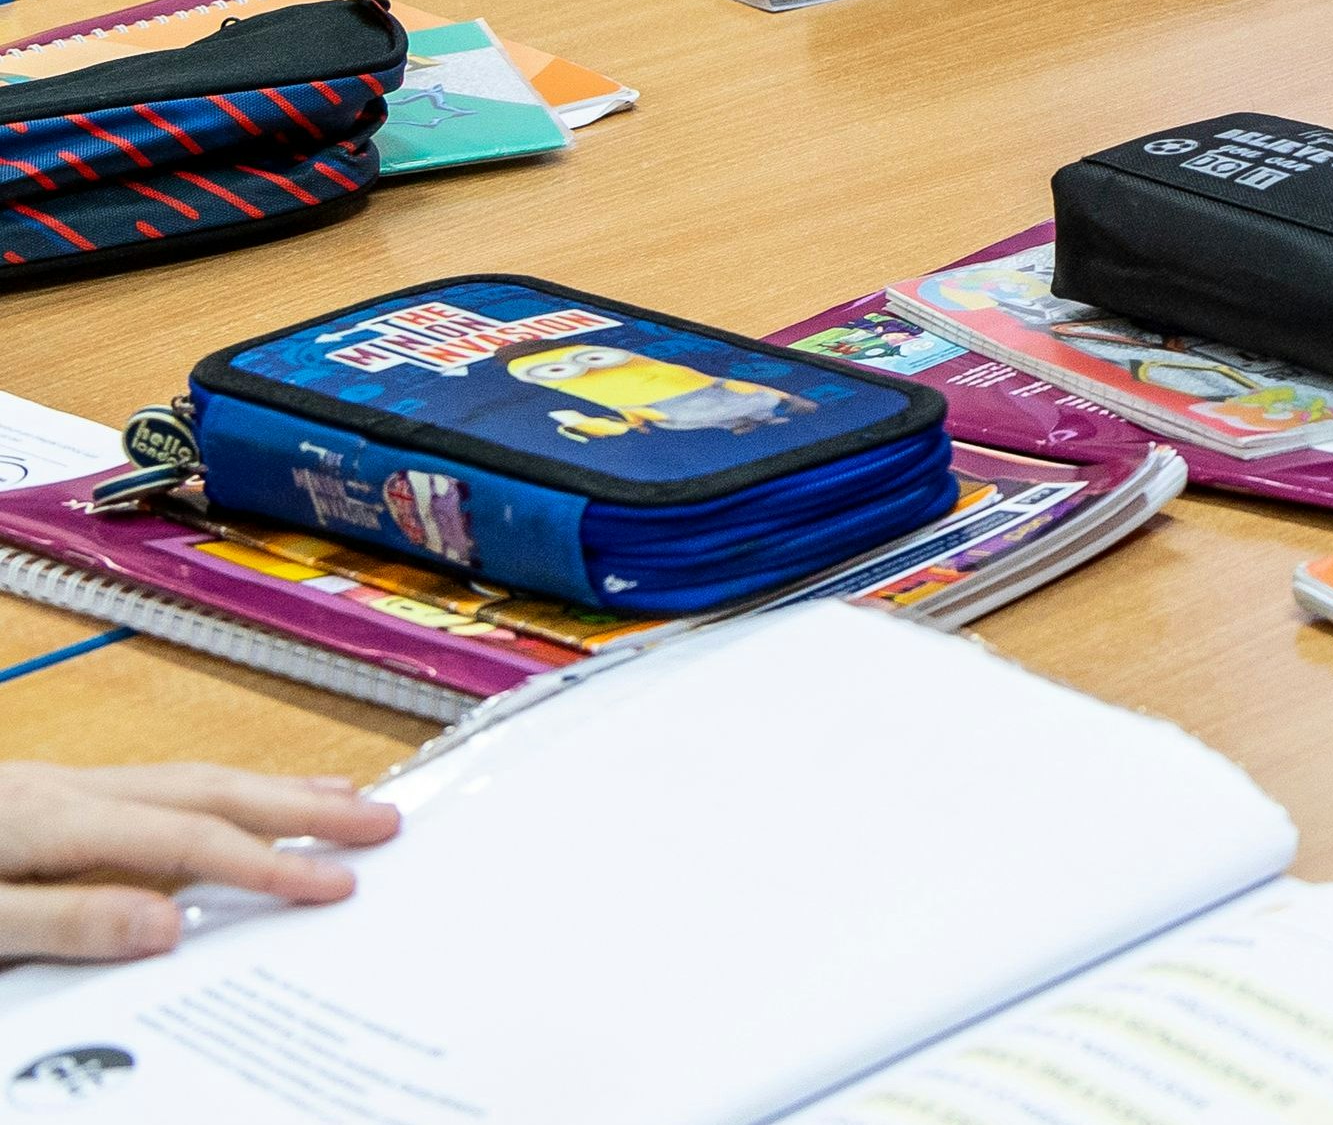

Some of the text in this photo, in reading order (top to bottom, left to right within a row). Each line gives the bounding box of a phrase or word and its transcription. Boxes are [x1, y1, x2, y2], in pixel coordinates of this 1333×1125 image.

[334, 315, 500, 367] MINION
[371, 305, 462, 333] THE
[408, 311, 608, 367] INVASION
